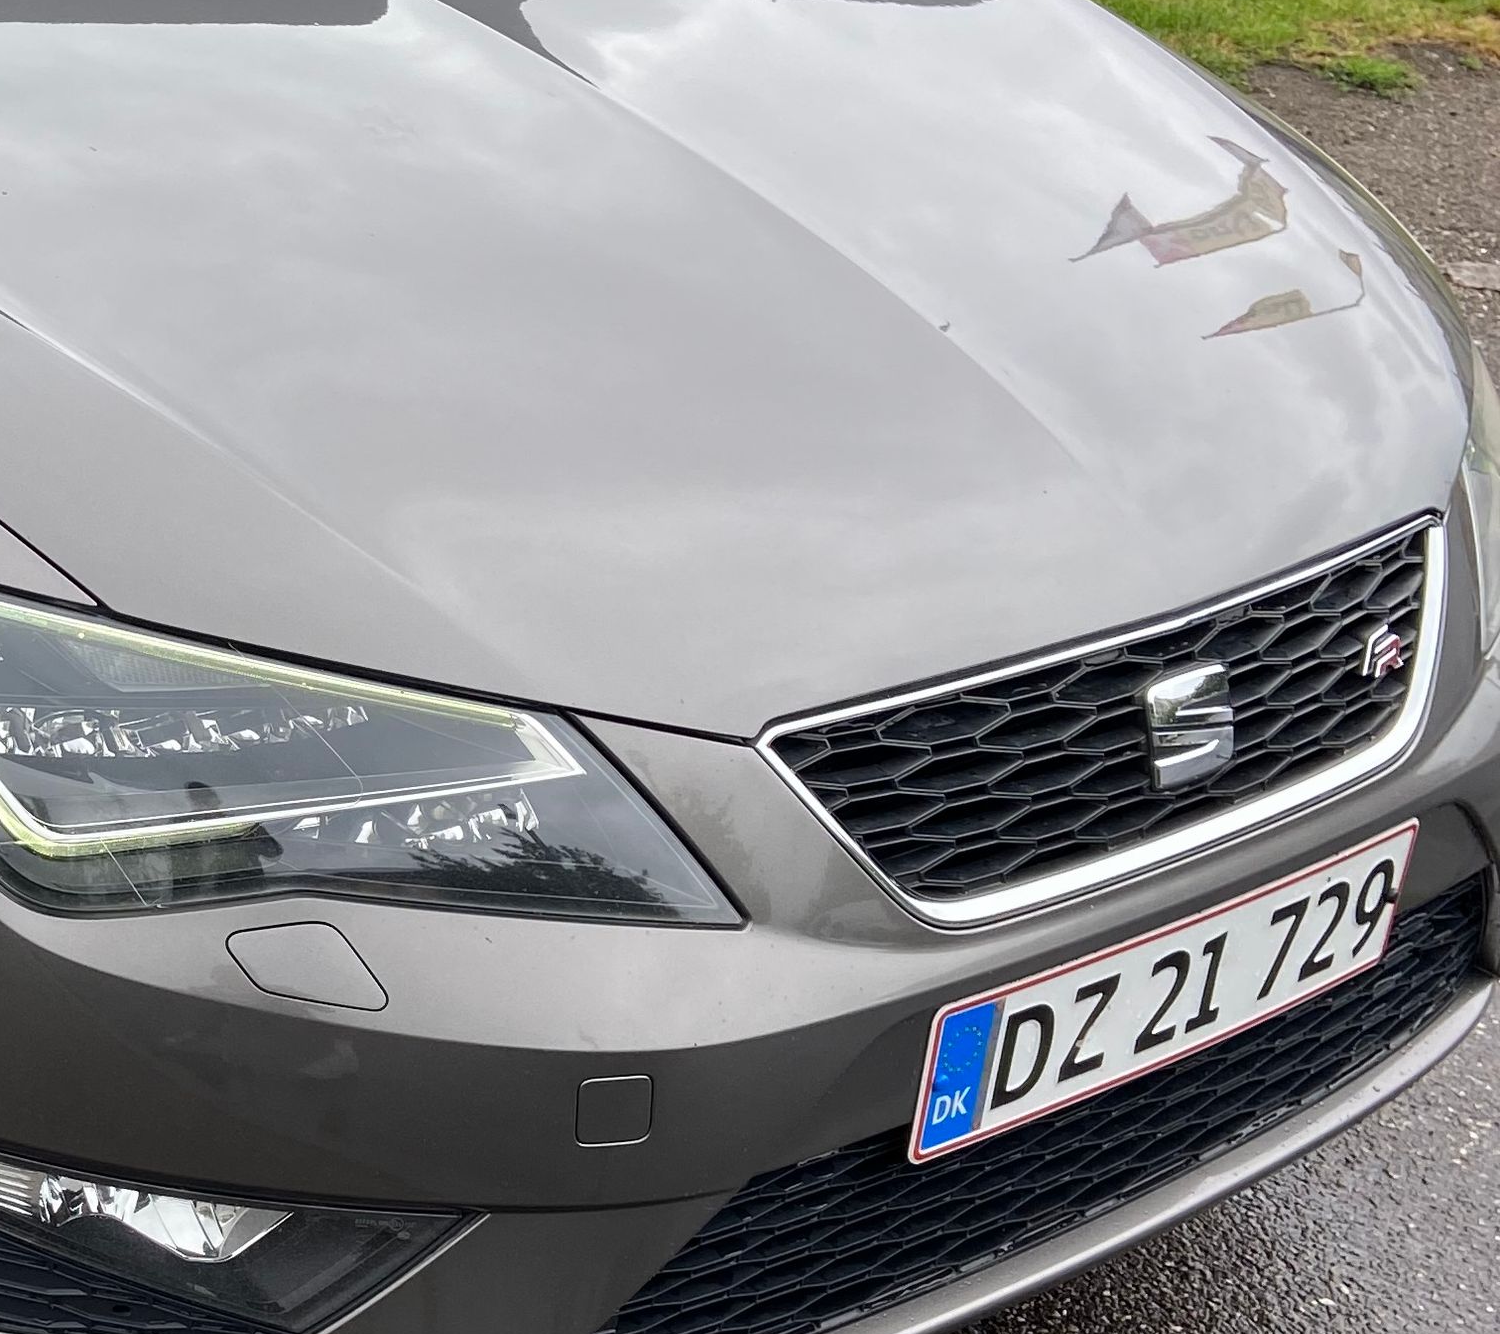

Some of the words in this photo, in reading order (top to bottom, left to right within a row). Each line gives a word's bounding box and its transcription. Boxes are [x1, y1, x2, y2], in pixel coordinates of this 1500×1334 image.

[989, 972, 1122, 1111] DZ
[1133, 931, 1229, 1055] 21
[1256, 858, 1396, 1001] 729
[931, 1086, 969, 1127] DK
